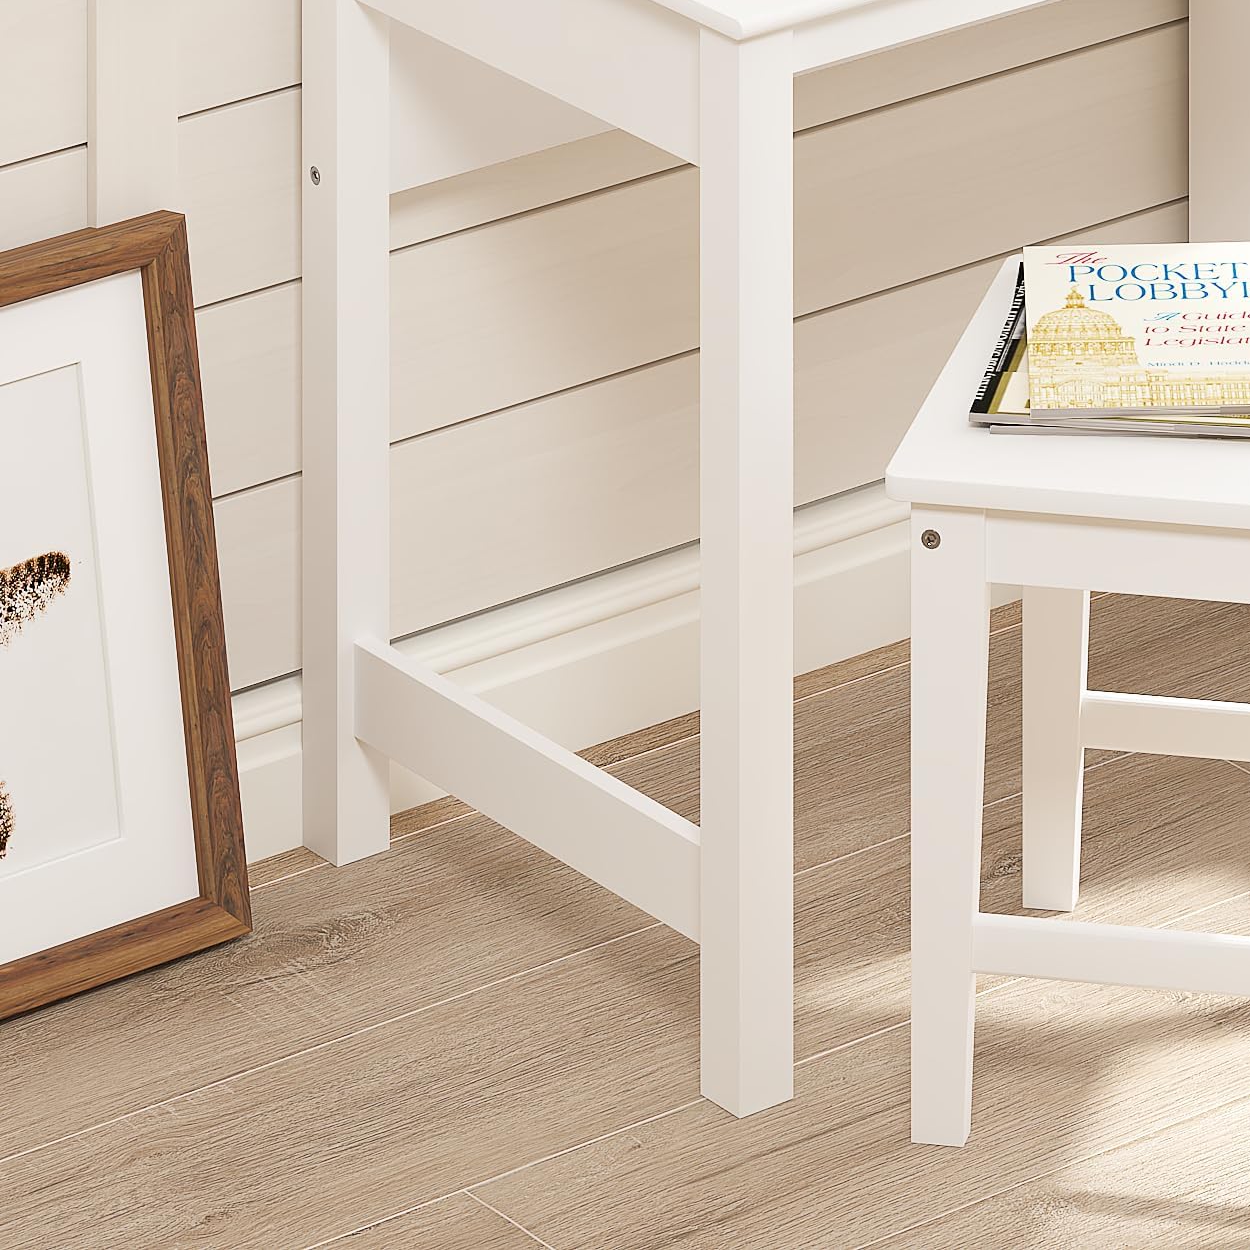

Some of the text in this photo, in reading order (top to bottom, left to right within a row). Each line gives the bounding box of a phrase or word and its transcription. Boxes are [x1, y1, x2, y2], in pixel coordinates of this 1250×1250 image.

[1044, 250, 1108, 265] The
[1069, 262, 1249, 283] POCKET
[1145, 324, 1248, 334] to State
